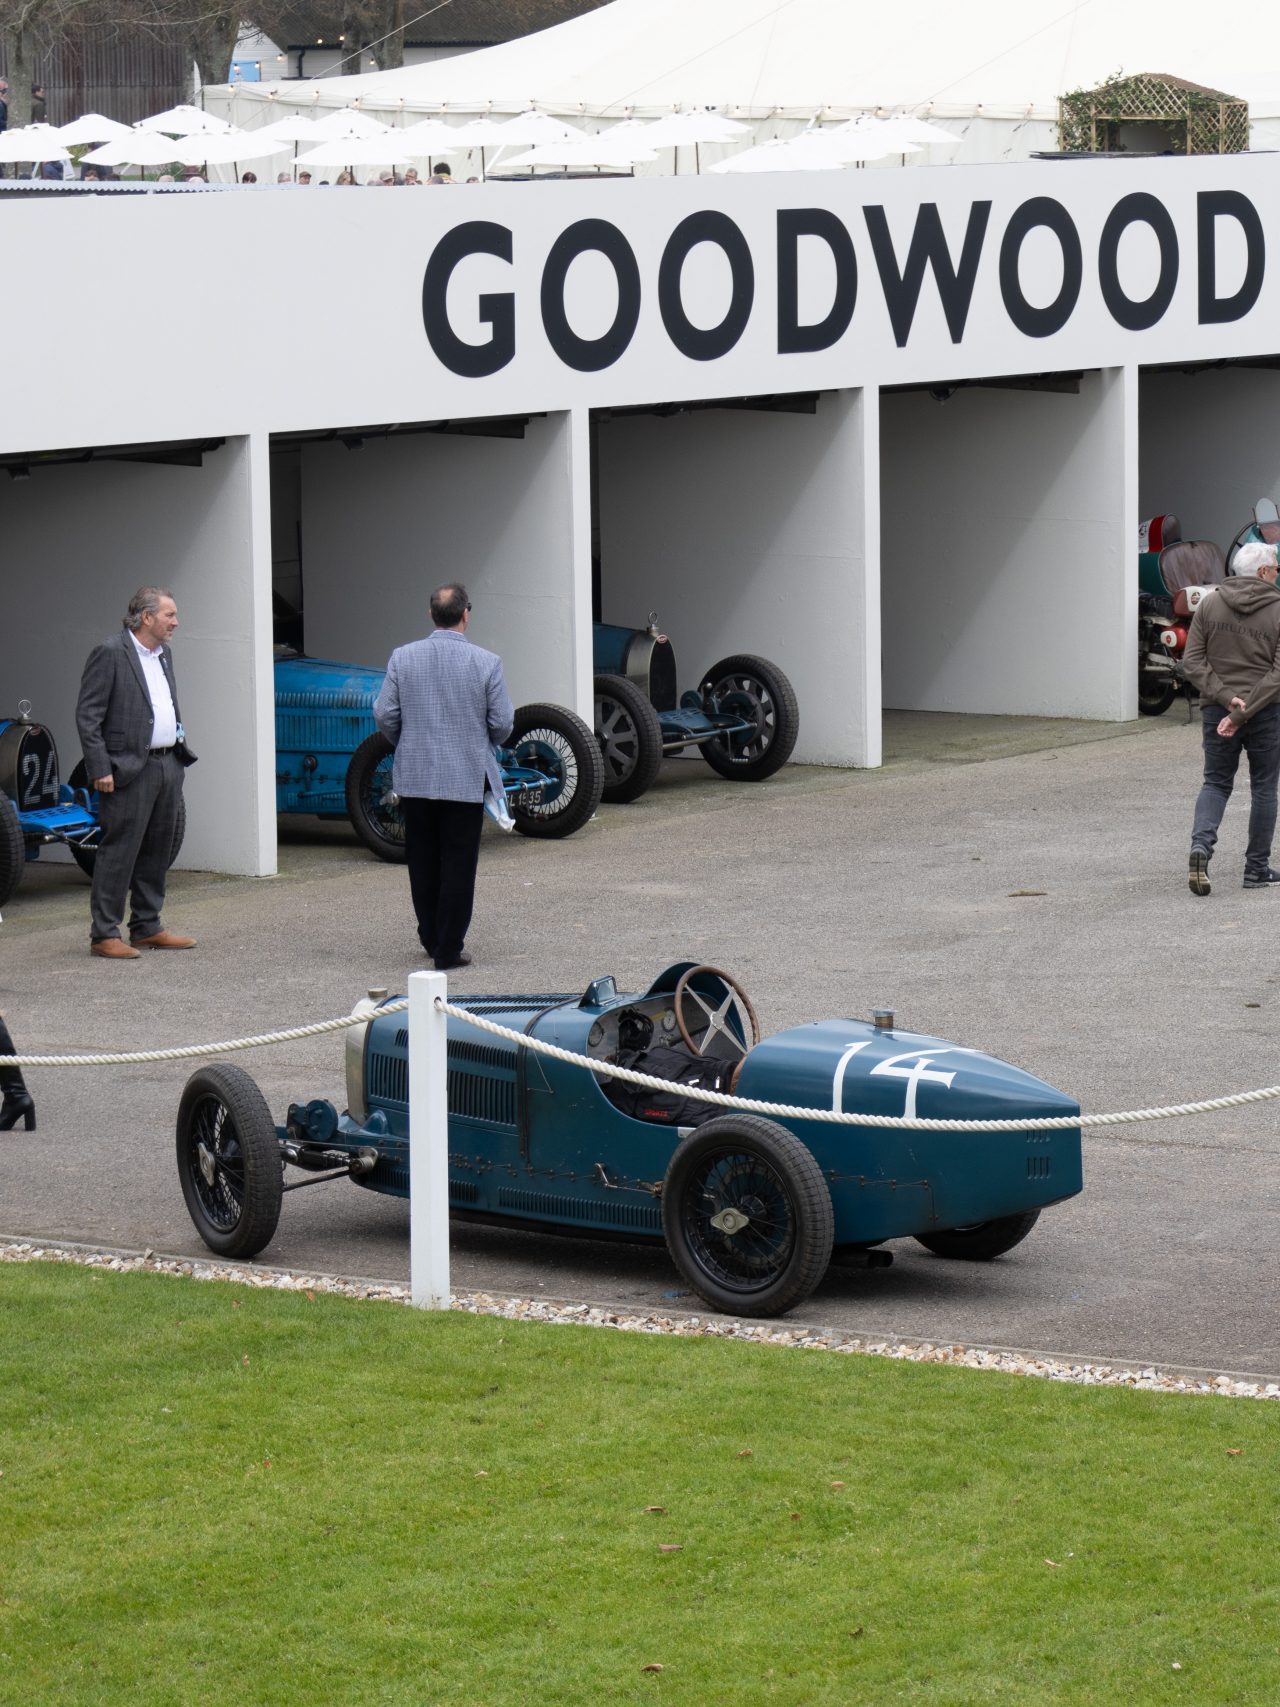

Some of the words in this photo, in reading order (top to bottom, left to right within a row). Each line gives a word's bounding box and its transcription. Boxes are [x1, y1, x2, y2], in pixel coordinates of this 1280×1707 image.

[422, 189, 1267, 378] GOODWOOD
[22, 750, 60, 805] 24
[832, 1040, 958, 1119] 14
